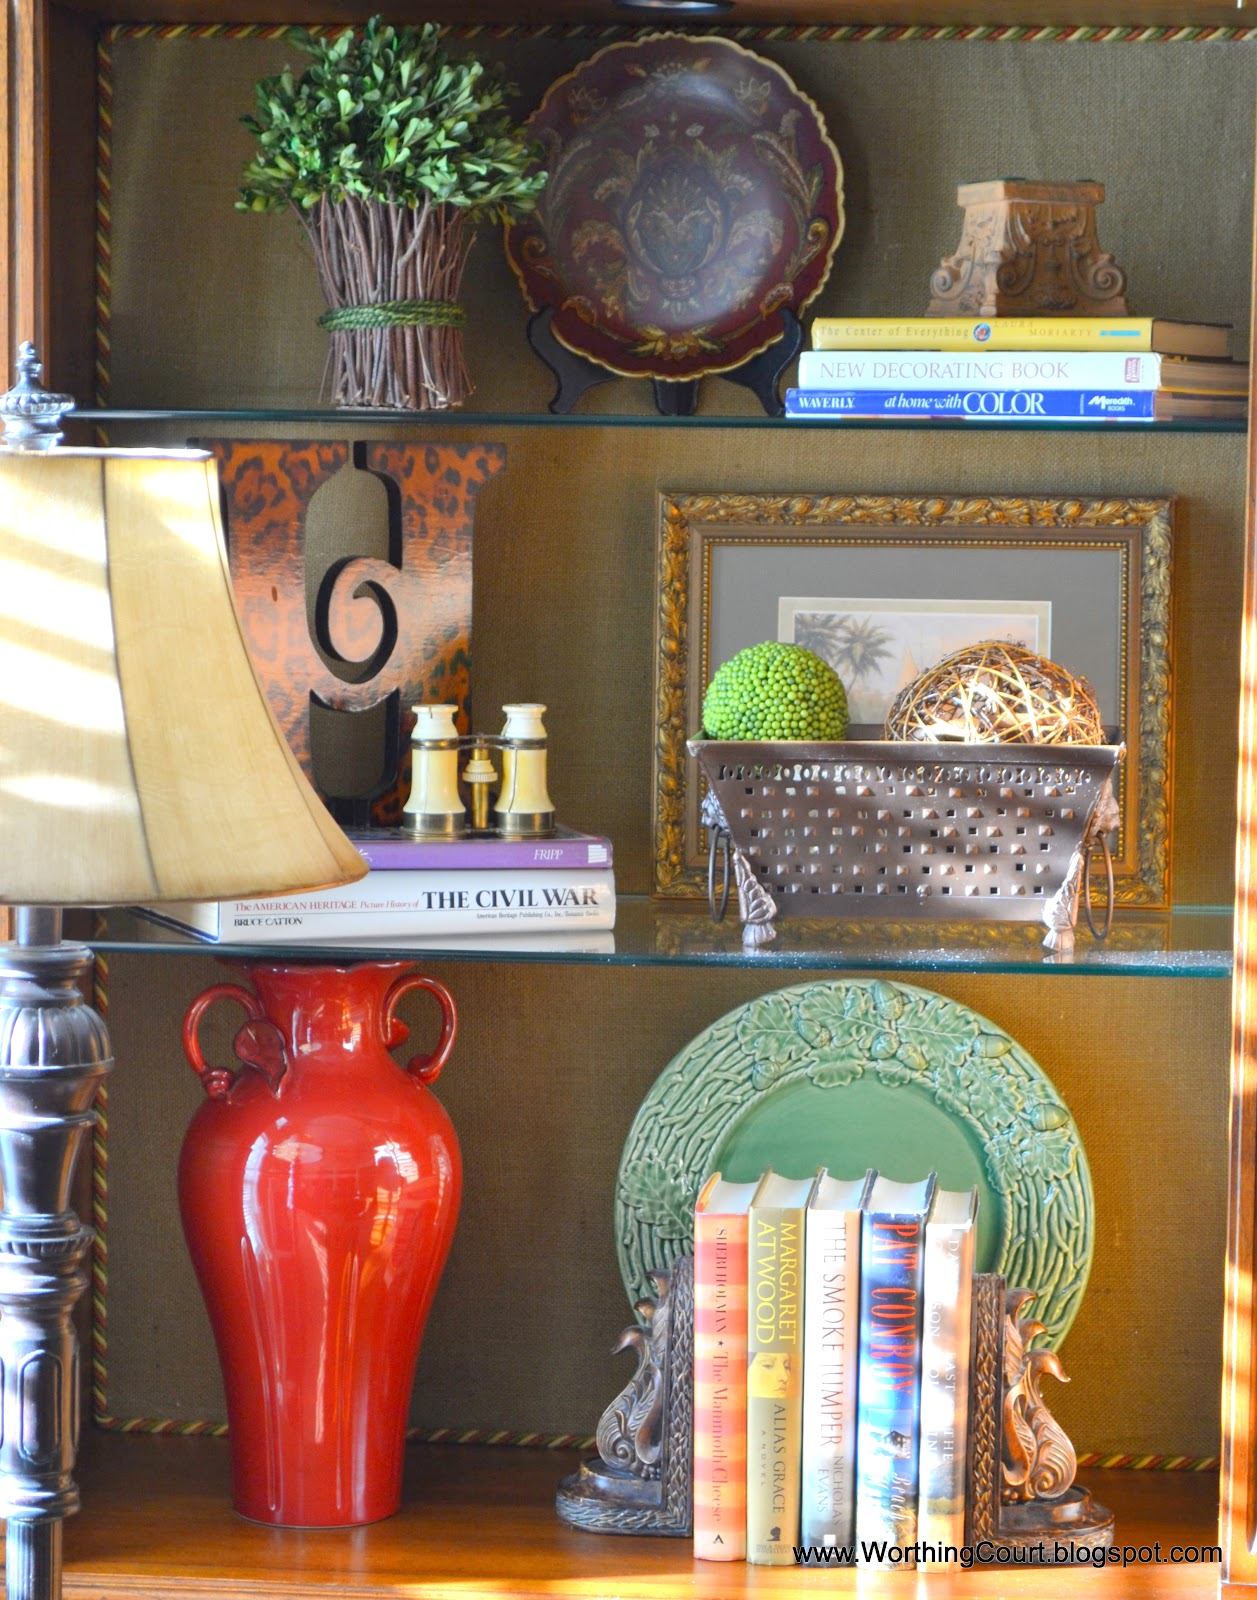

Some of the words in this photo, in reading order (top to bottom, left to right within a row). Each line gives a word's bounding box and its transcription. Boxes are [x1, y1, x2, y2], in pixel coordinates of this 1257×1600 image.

[820, 325, 840, 337] The
[845, 325, 883, 337] Center
[888, 325, 901, 337] of
[906, 325, 970, 340] Everything
[992, 320, 1034, 329] LAURA
[1028, 328, 1093, 337] MORIARTY
[820, 362, 866, 378] NEW
[872, 362, 1003, 379] DECORATING
[1011, 362, 1070, 379] BOOK
[799, 396, 856, 409] WAVERLY
[884, 395, 897, 409] at
[897, 392, 932, 409] home
[933, 393, 962, 409] with
[962, 391, 1047, 415] COLOR
[1088, 395, 1134, 410] Meredith
[533, 848, 564, 861] FRIPP
[233, 902, 251, 912] The
[252, 901, 308, 912] AMERICAN
[309, 900, 357, 911] HERITAGE
[359, 900, 385, 909] Picture
[386, 900, 412, 910] History
[412, 899, 420, 909] of
[422, 890, 470, 910] THE
[475, 889, 539, 908] CIVIL
[541, 887, 600, 906] WAR
[498, 912, 518, 920] Heritage
[233, 917, 264, 927] BRUCE
[265, 917, 303, 926] CATTON
[716, 1228, 727, 1269] SHERI
[823, 1222, 847, 1264] THE
[872, 1221, 919, 1271] PAT
[755, 1219, 777, 1345] ATWOOD
[778, 1222, 798, 1345] MARGARET
[716, 1274, 727, 1333] HOLMAN
[822, 1273, 846, 1352] SMOKE
[869, 1287, 918, 1396] CONROY
[712, 1351, 729, 1383] The
[711, 1387, 728, 1463] Mammoth
[819, 1363, 844, 1448] JUMPER
[773, 1404, 787, 1454] ALIAS
[942, 1429, 955, 1463] THE
[711, 1467, 728, 1523] Cheese
[772, 1460, 786, 1513] GRACE
[817, 1468, 829, 1514] EVANS
[832, 1455, 845, 1526] NICHOLAS
[889, 1471, 913, 1521] Beach
